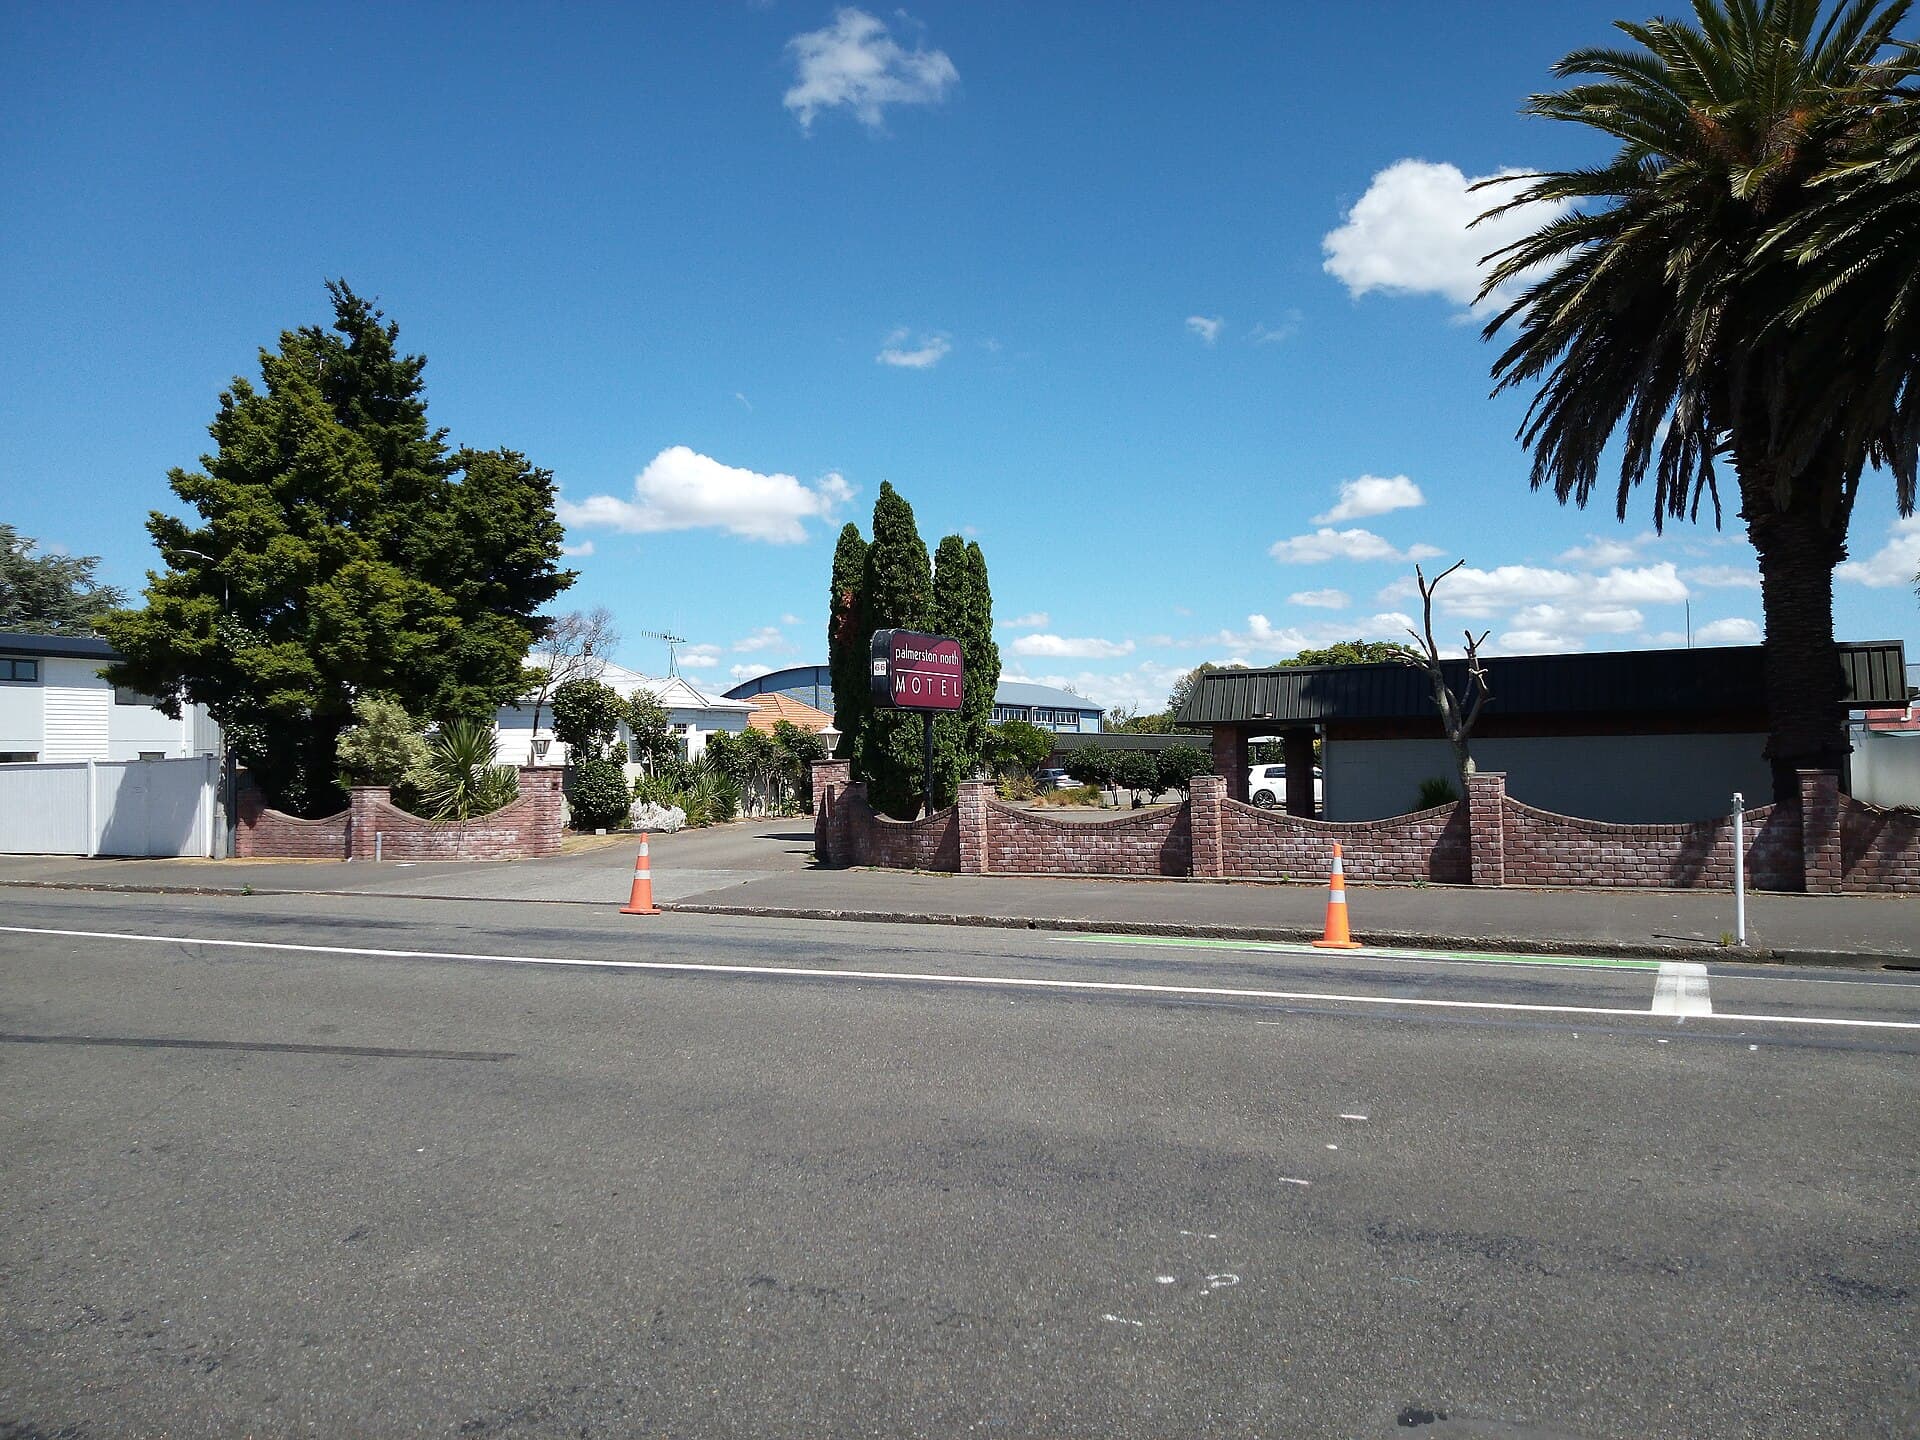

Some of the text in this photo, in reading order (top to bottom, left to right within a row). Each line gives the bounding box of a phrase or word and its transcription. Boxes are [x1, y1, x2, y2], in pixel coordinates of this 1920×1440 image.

[896, 643, 958, 665] palmerston north
[896, 675, 959, 697] MOTEL
